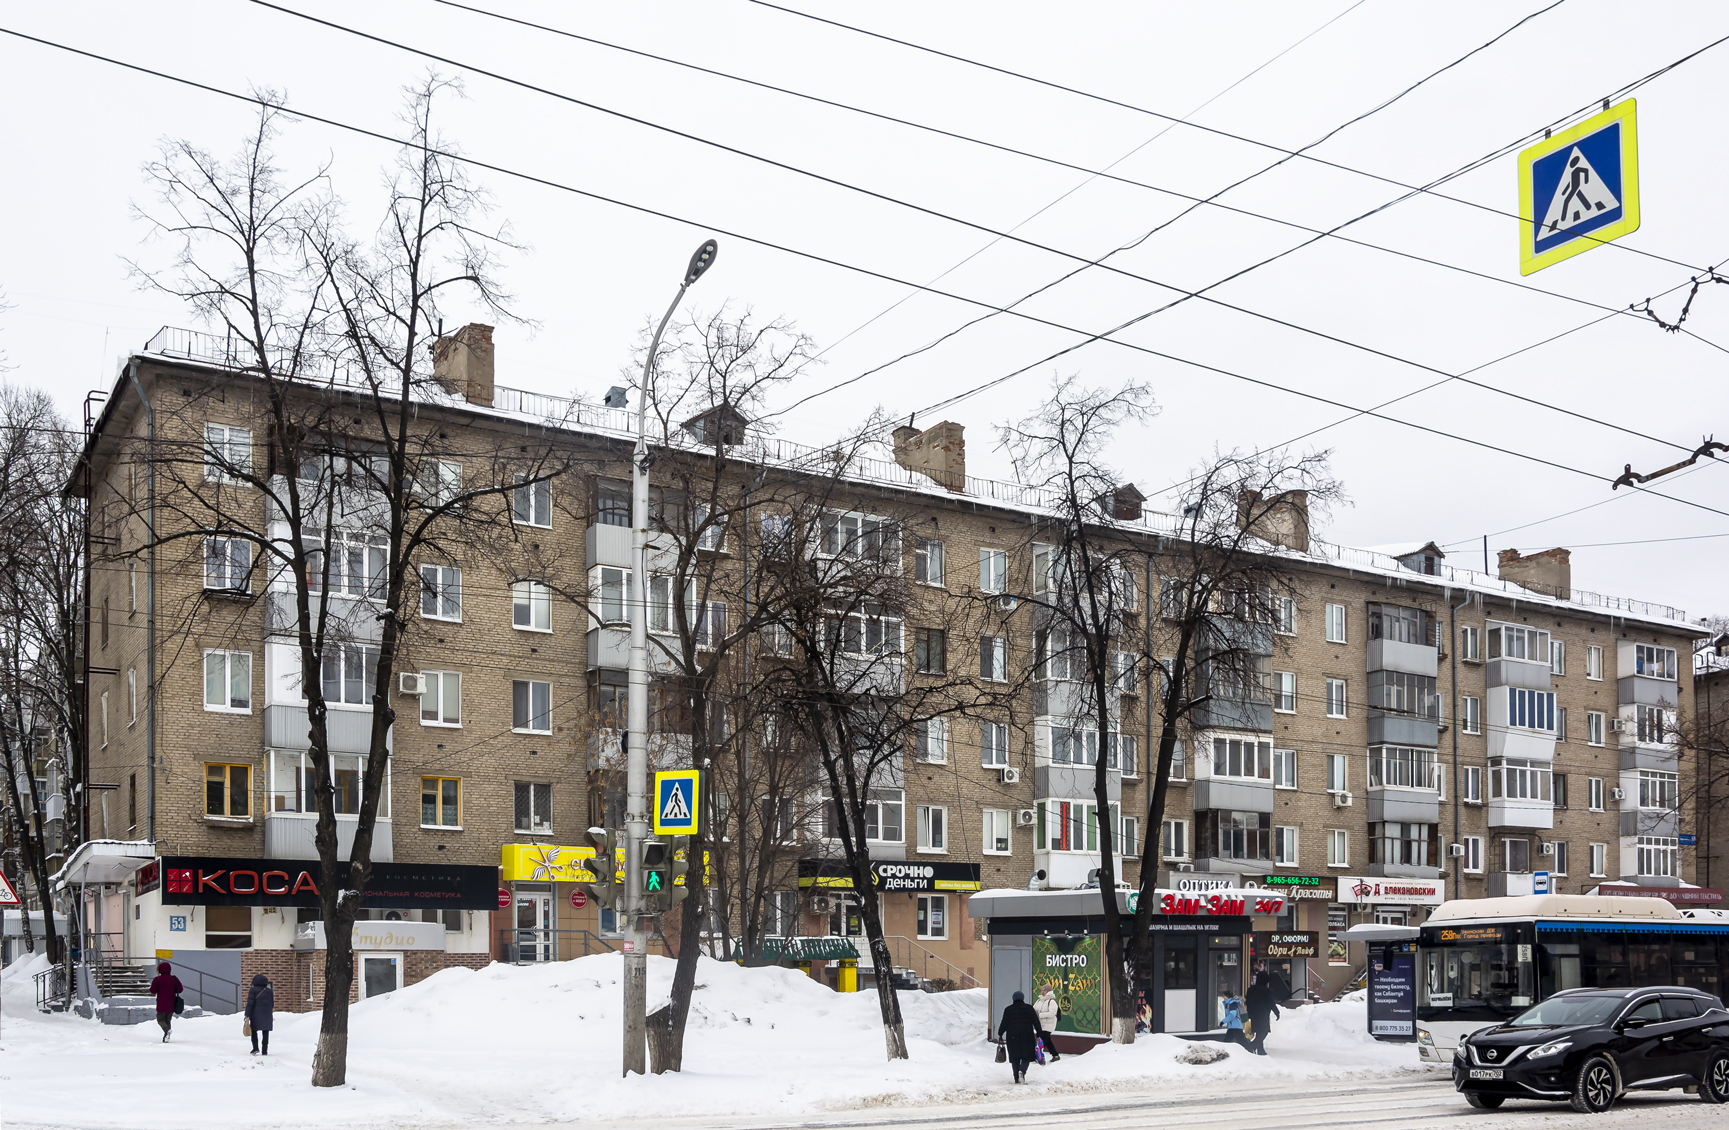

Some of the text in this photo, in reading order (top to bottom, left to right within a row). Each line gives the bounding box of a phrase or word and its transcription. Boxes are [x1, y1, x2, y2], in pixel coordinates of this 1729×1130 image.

[878, 865, 934, 878] СРОЧНО
[198, 869, 320, 895] КОСА
[885, 877, 928, 890] деньги
[1179, 879, 1234, 892] ОПТИКА
[1266, 876, 1319, 885] 8-965-656-72-32
[1289, 885, 1333, 901] Красоты
[1255, 897, 1284, 915] 24/7
[171, 917, 186, 930] 53
[1046, 954, 1087, 967] БИСТРО
